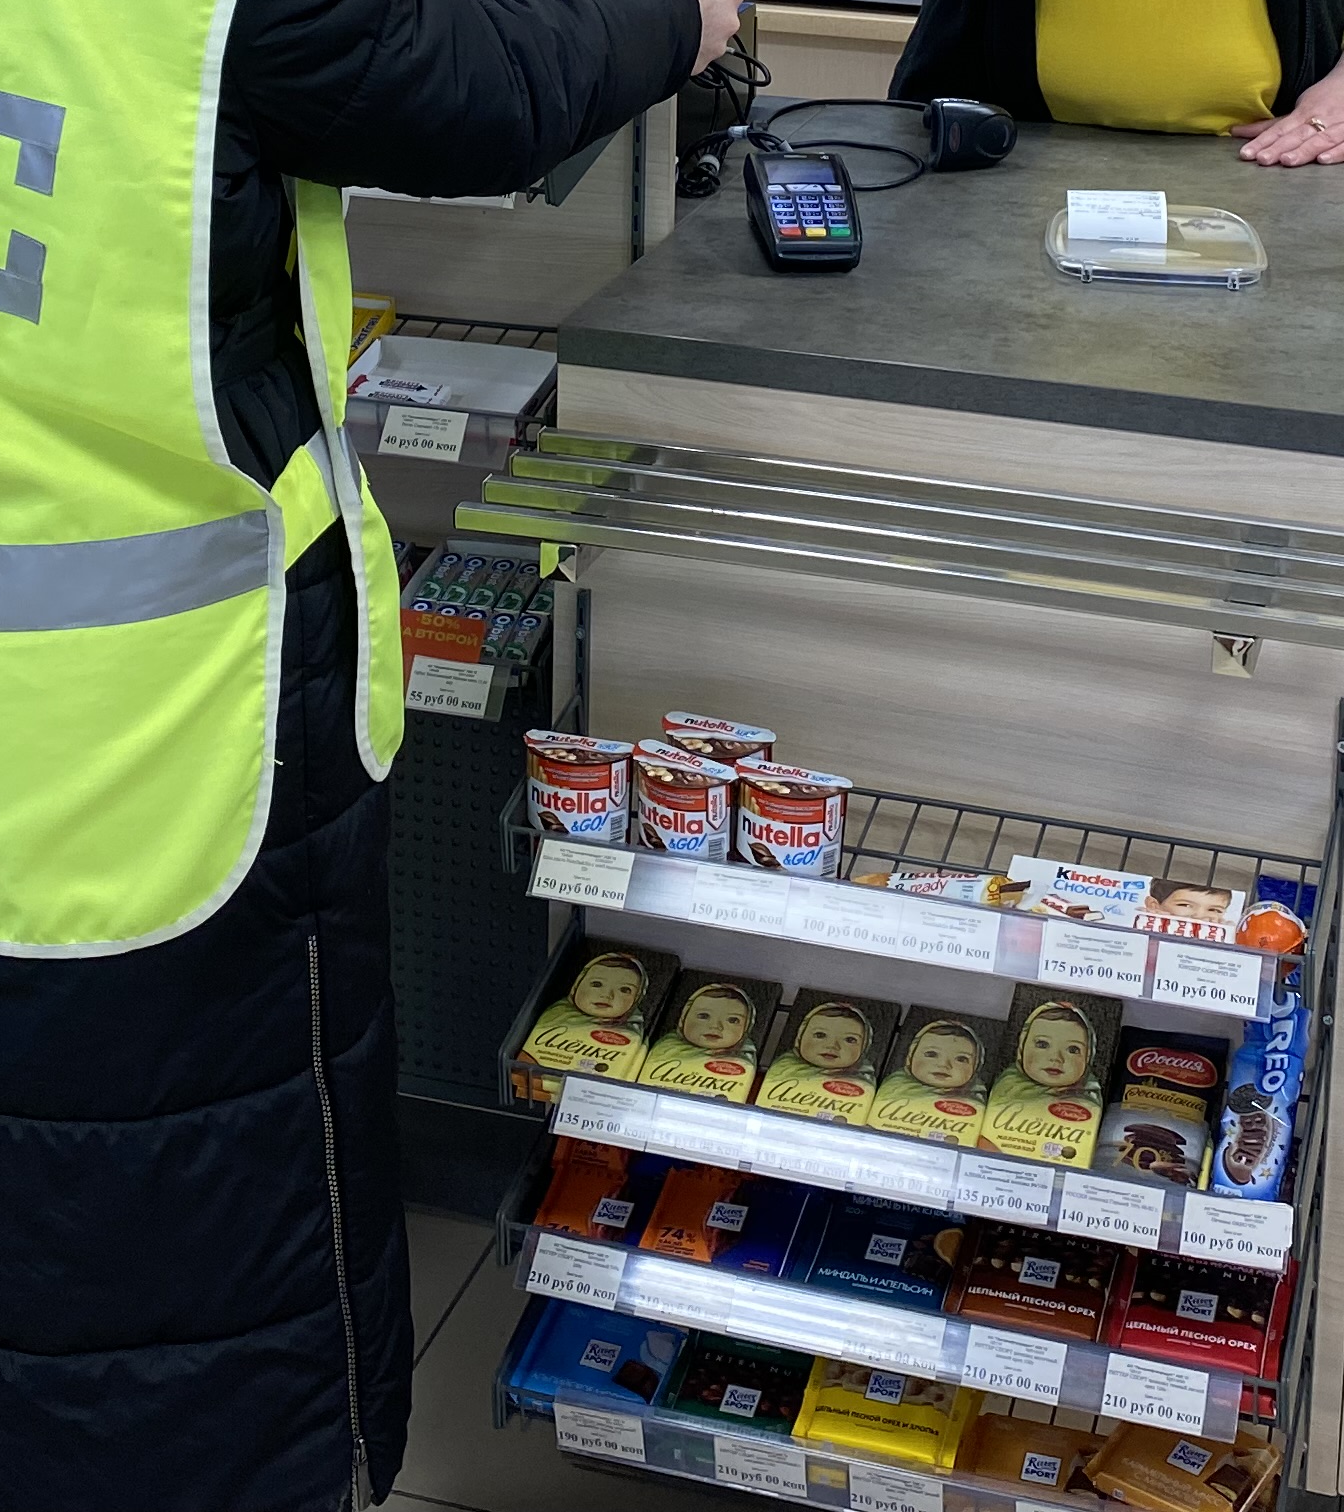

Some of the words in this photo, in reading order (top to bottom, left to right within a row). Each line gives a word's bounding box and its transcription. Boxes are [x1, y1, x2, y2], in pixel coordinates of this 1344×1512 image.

[531, 786, 607, 814] nutella
[742, 811, 820, 848] nutella
[1053, 879, 1138, 904] CHOCOLATE
[1044, 959, 1063, 972] 175
[1066, 962, 1090, 979] руб
[1093, 967, 1111, 979] 00
[1114, 970, 1142, 985] коп
[993, 1100, 1086, 1145] Алёнка
[1182, 1230, 1204, 1245] 100
[1207, 1235, 1232, 1251] руб
[1235, 1239, 1253, 1253] 00
[1256, 1245, 1283, 1259] коп
[1126, 1320, 1178, 1337] ЦЕЛЬНЫЙ
[1180, 1327, 1225, 1345] ЛЕСНОЙ
[1228, 1336, 1257, 1354] ОРЕХ
